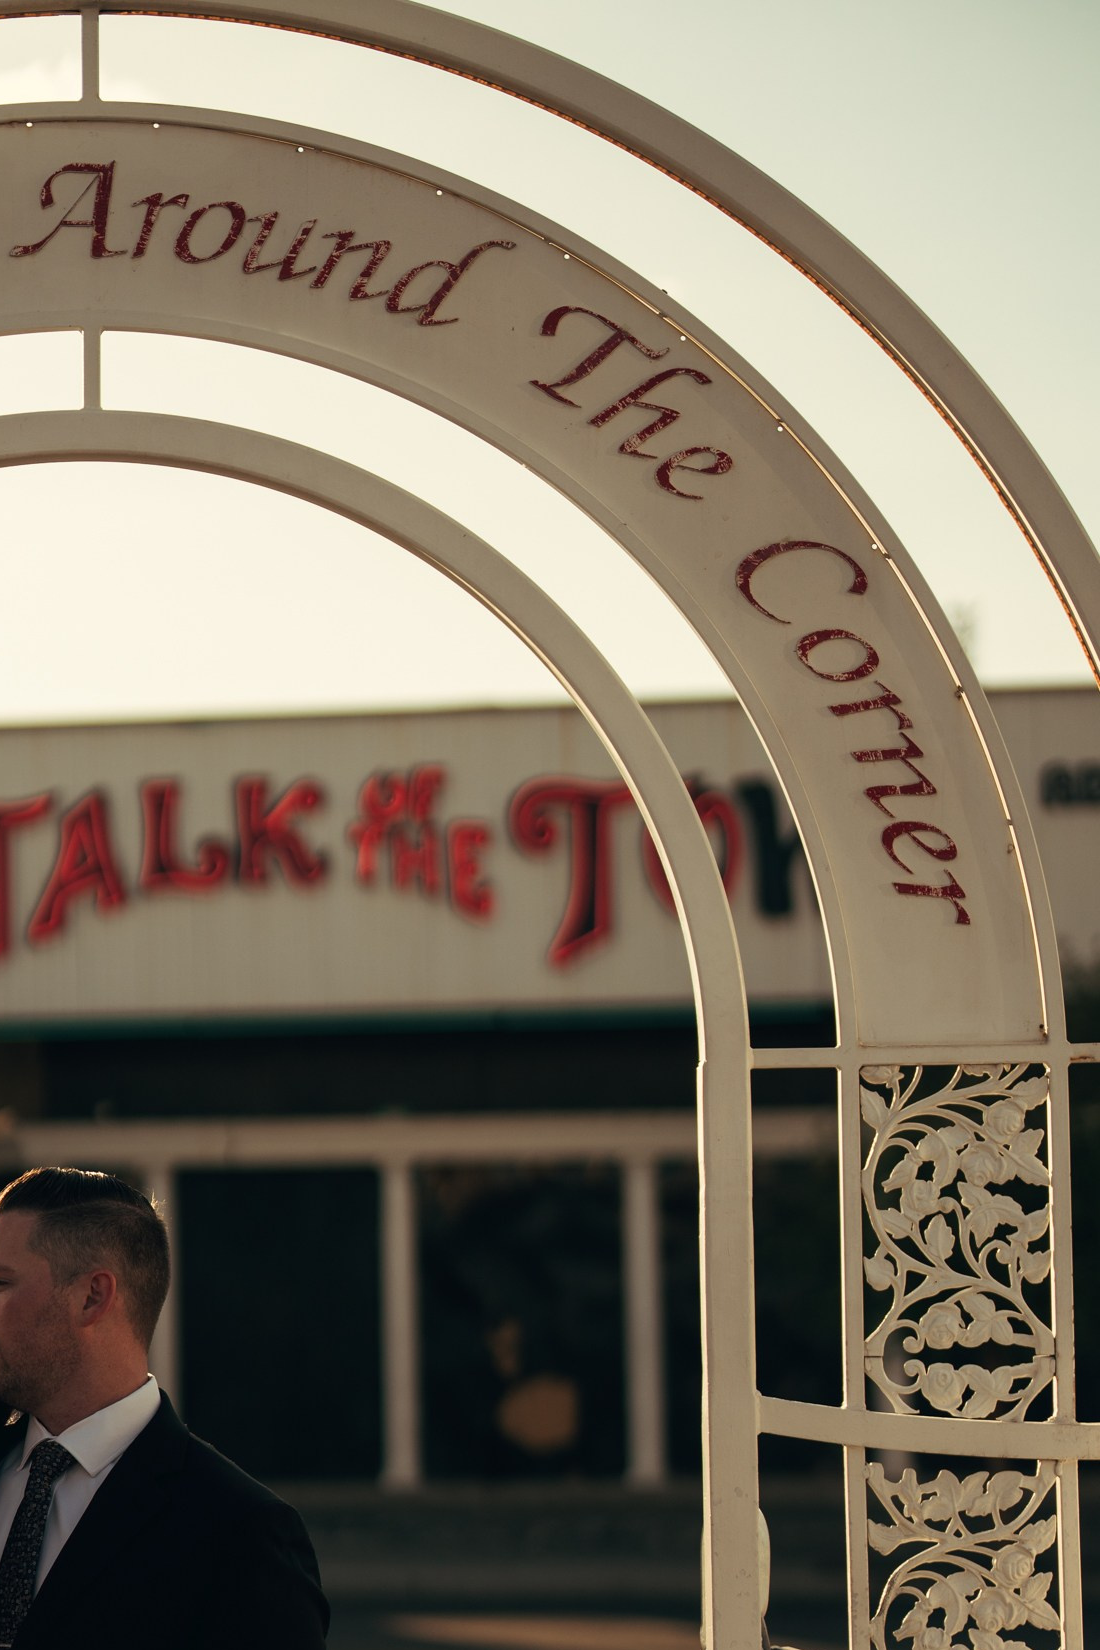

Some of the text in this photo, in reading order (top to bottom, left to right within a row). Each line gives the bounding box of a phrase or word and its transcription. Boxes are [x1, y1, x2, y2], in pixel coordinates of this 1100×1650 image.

[9, 160, 517, 326] Around
[529, 305, 733, 500] The
[735, 540, 971, 926] Corner
[345, 818, 495, 924] THE
